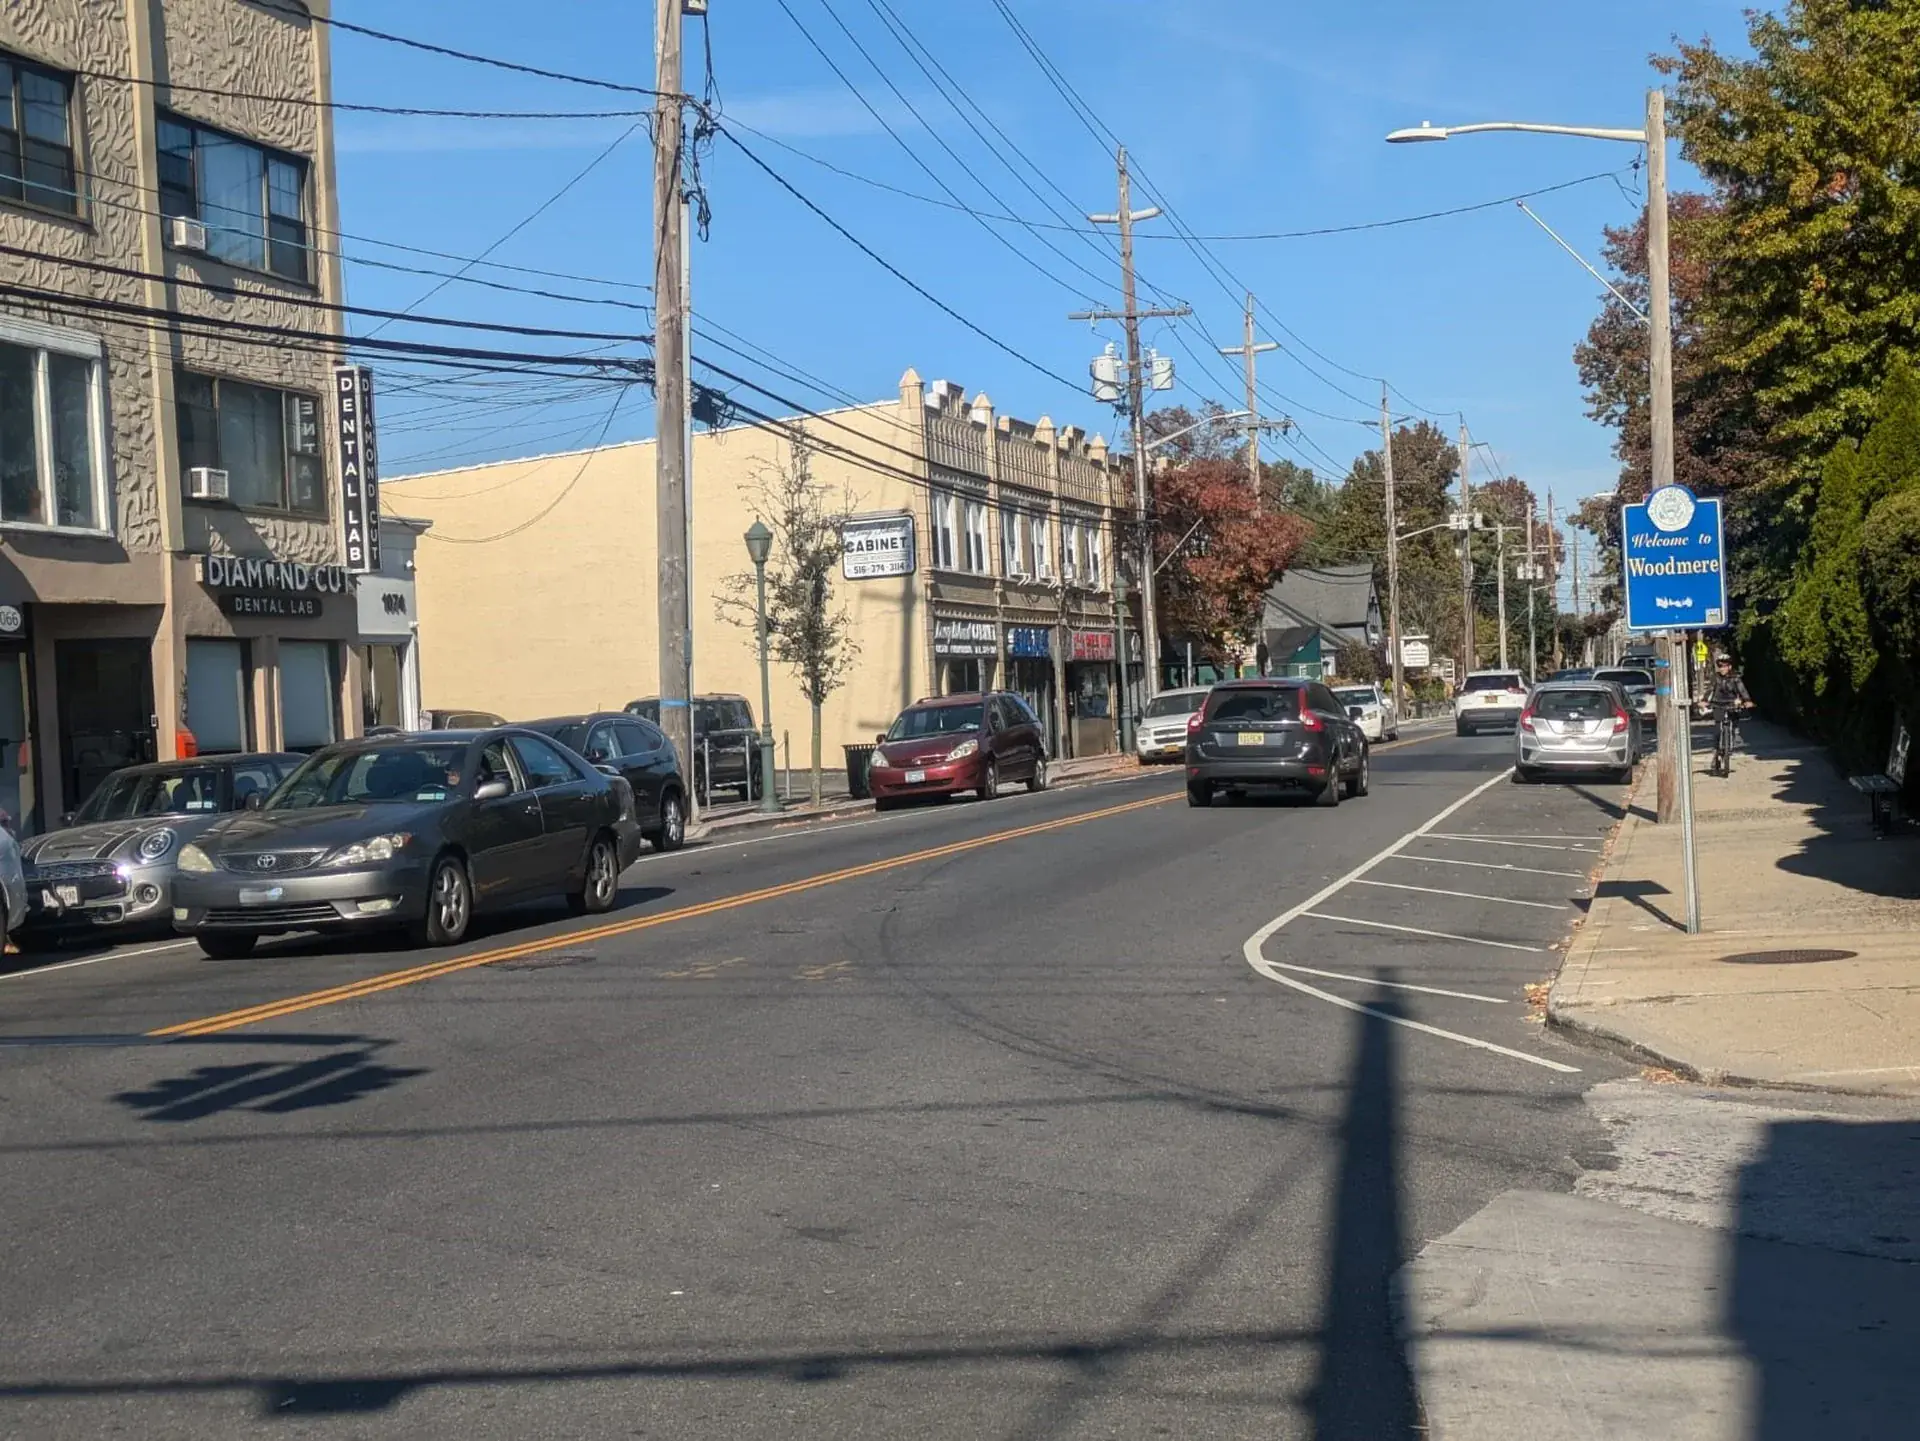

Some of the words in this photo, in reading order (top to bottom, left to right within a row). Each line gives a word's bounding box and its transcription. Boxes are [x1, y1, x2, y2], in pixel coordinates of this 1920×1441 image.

[340, 377, 358, 498] DENTAL
[362, 378, 376, 498] DIAMOND
[369, 510, 379, 561] CUT
[348, 510, 362, 562] LAB
[845, 537, 907, 553] CABINET
[1631, 533, 1689, 548] Welcome
[1698, 533, 1712, 544] to
[1628, 556, 1720, 577] Woodmere
[235, 596, 285, 613] DENTAL
[290, 600, 313, 614] LAB
